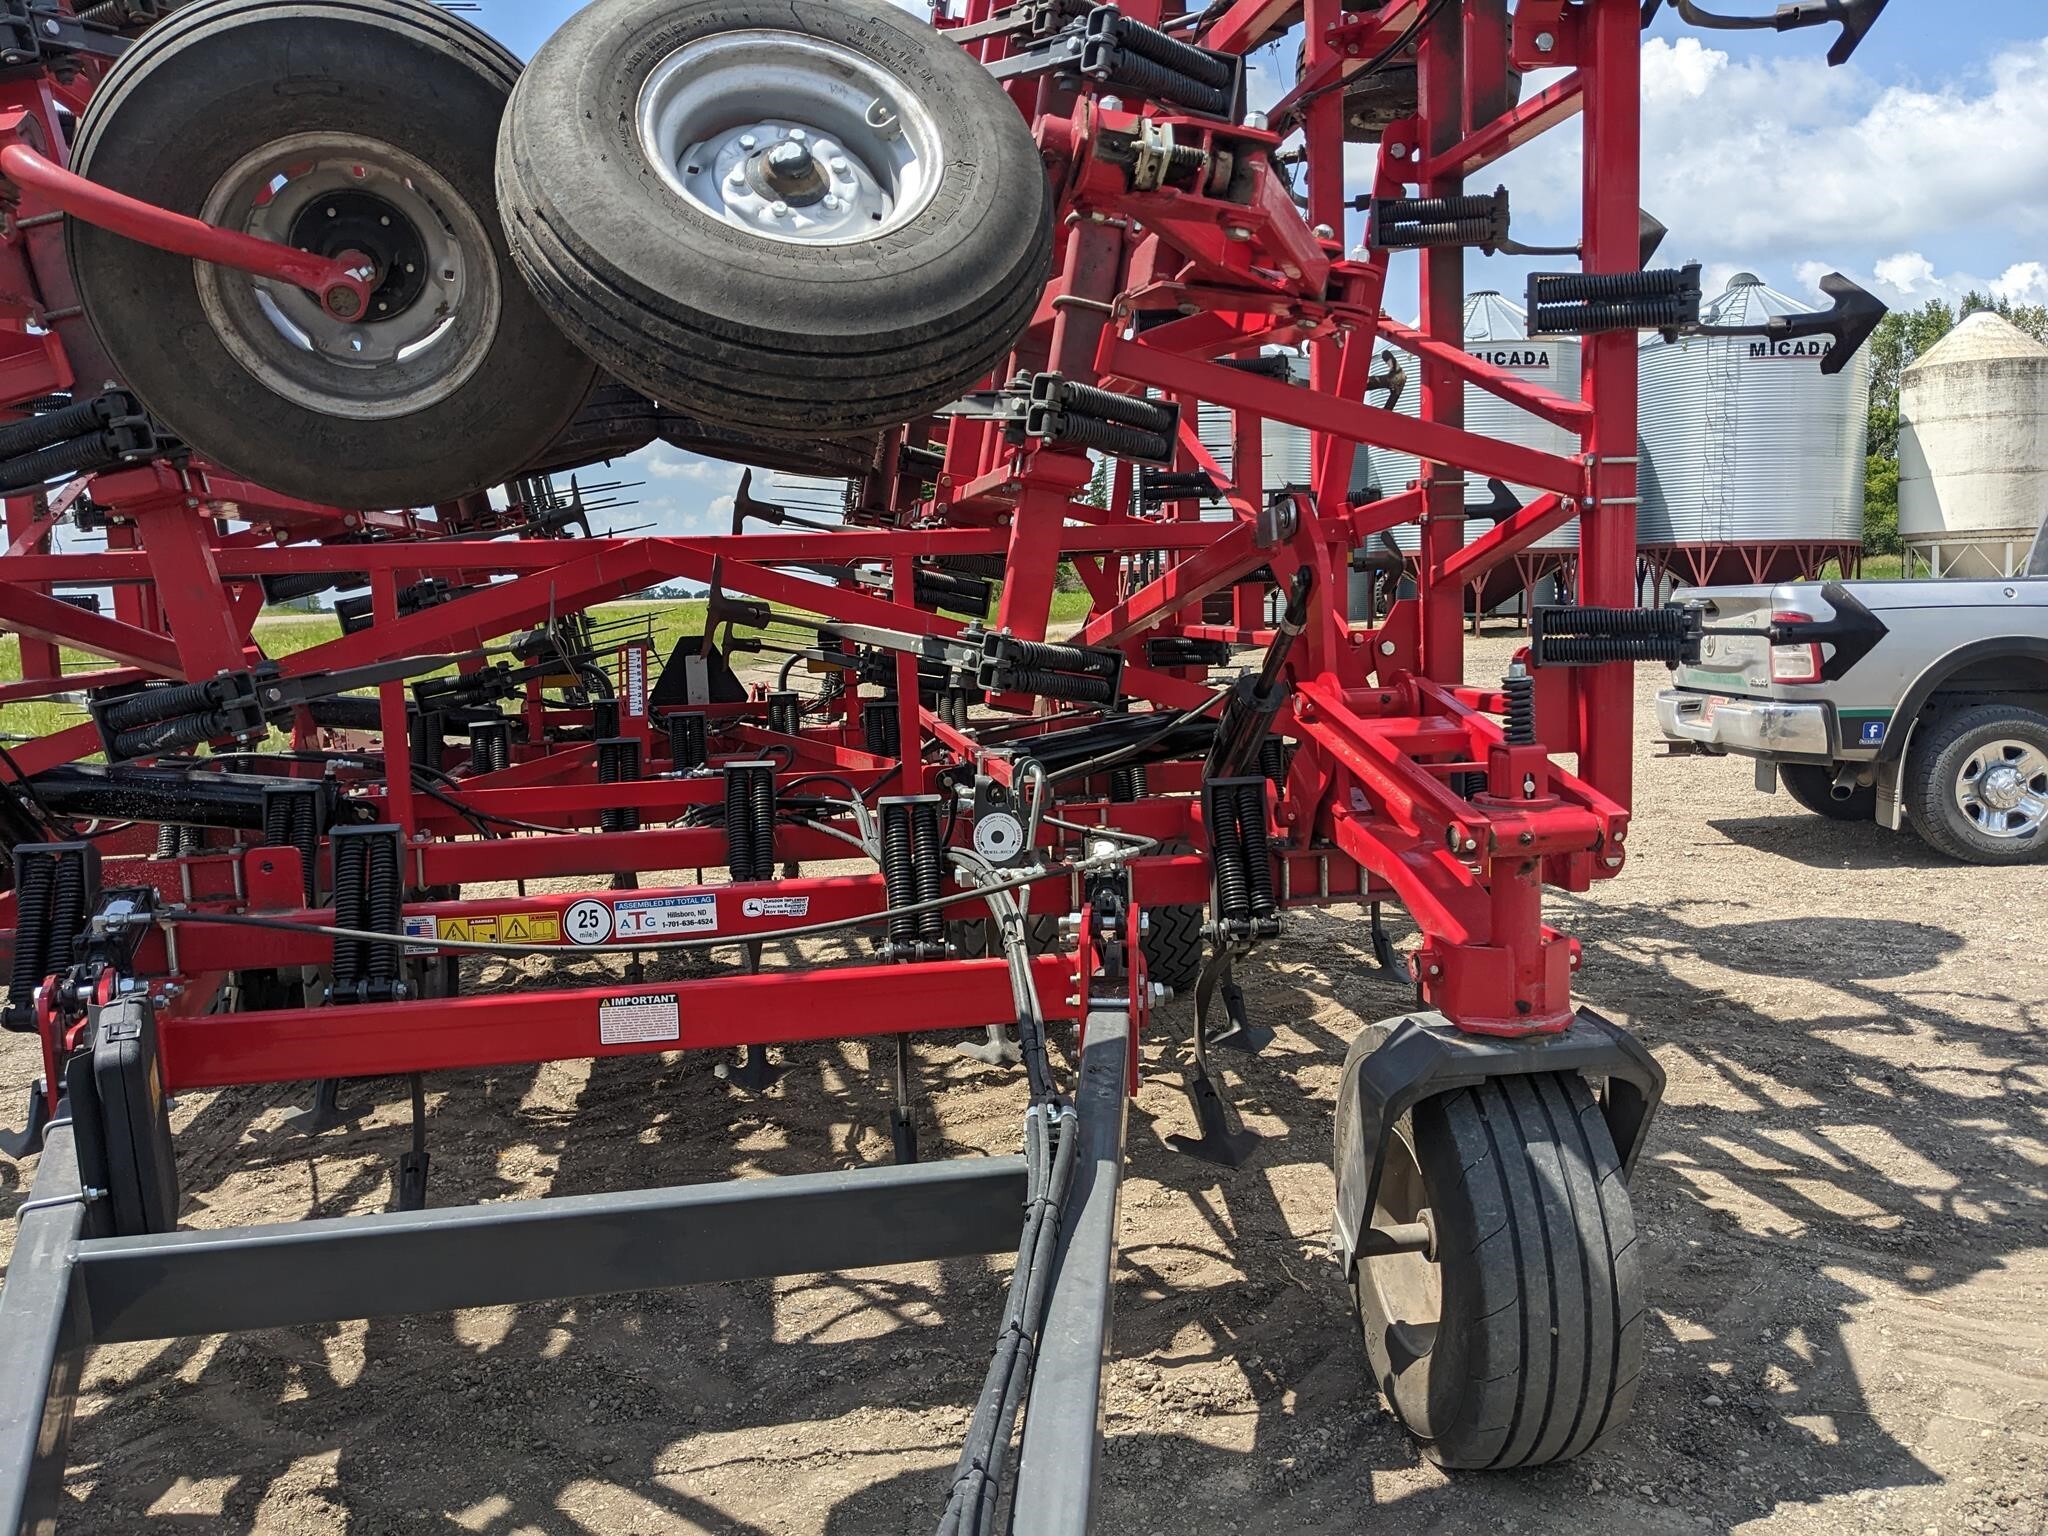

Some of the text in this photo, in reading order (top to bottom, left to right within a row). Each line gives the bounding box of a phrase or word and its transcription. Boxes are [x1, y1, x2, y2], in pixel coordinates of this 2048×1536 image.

[618, 900, 664, 910] ASSEMBLED
[677, 897, 699, 905] TOTAL
[577, 909, 599, 929] 25
[667, 911, 696, 919] Hillsboro,
[662, 918, 714, 928] 1-701-636-4524
[579, 930, 599, 939] mile/h
[611, 994, 676, 1006] IMPORTANT
